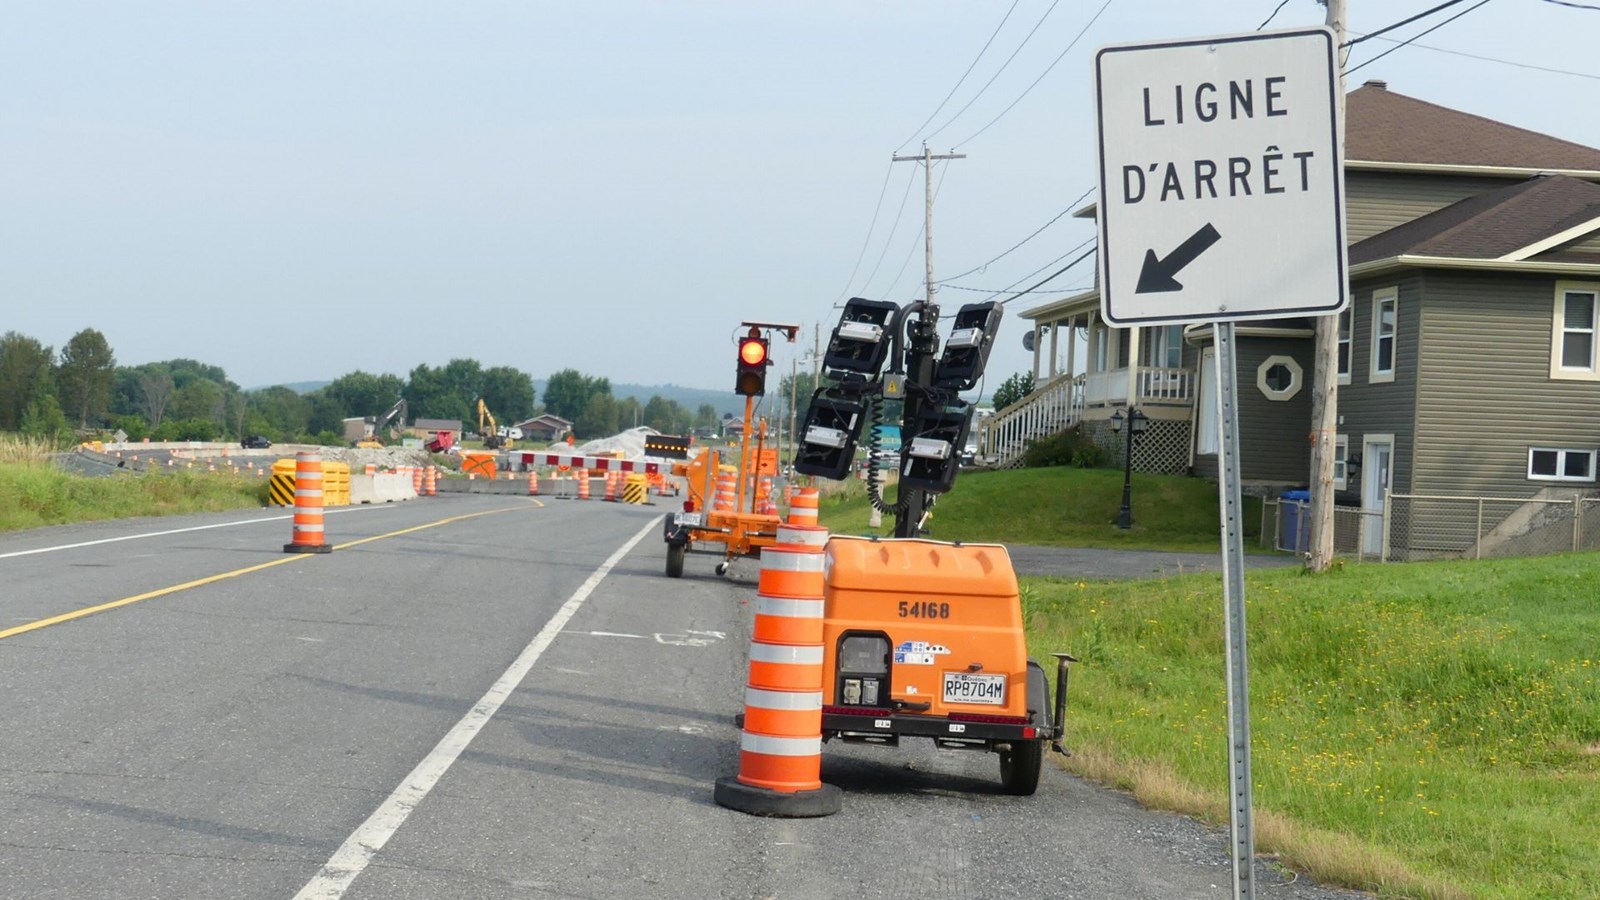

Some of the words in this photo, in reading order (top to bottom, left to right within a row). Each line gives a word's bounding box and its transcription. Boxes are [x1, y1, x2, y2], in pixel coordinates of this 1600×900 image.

[1143, 76, 1287, 126] LIGNE
[1123, 145, 1314, 204] D'ARRÊT
[898, 601, 950, 619] 54168
[945, 680, 1003, 698] RP8704M
